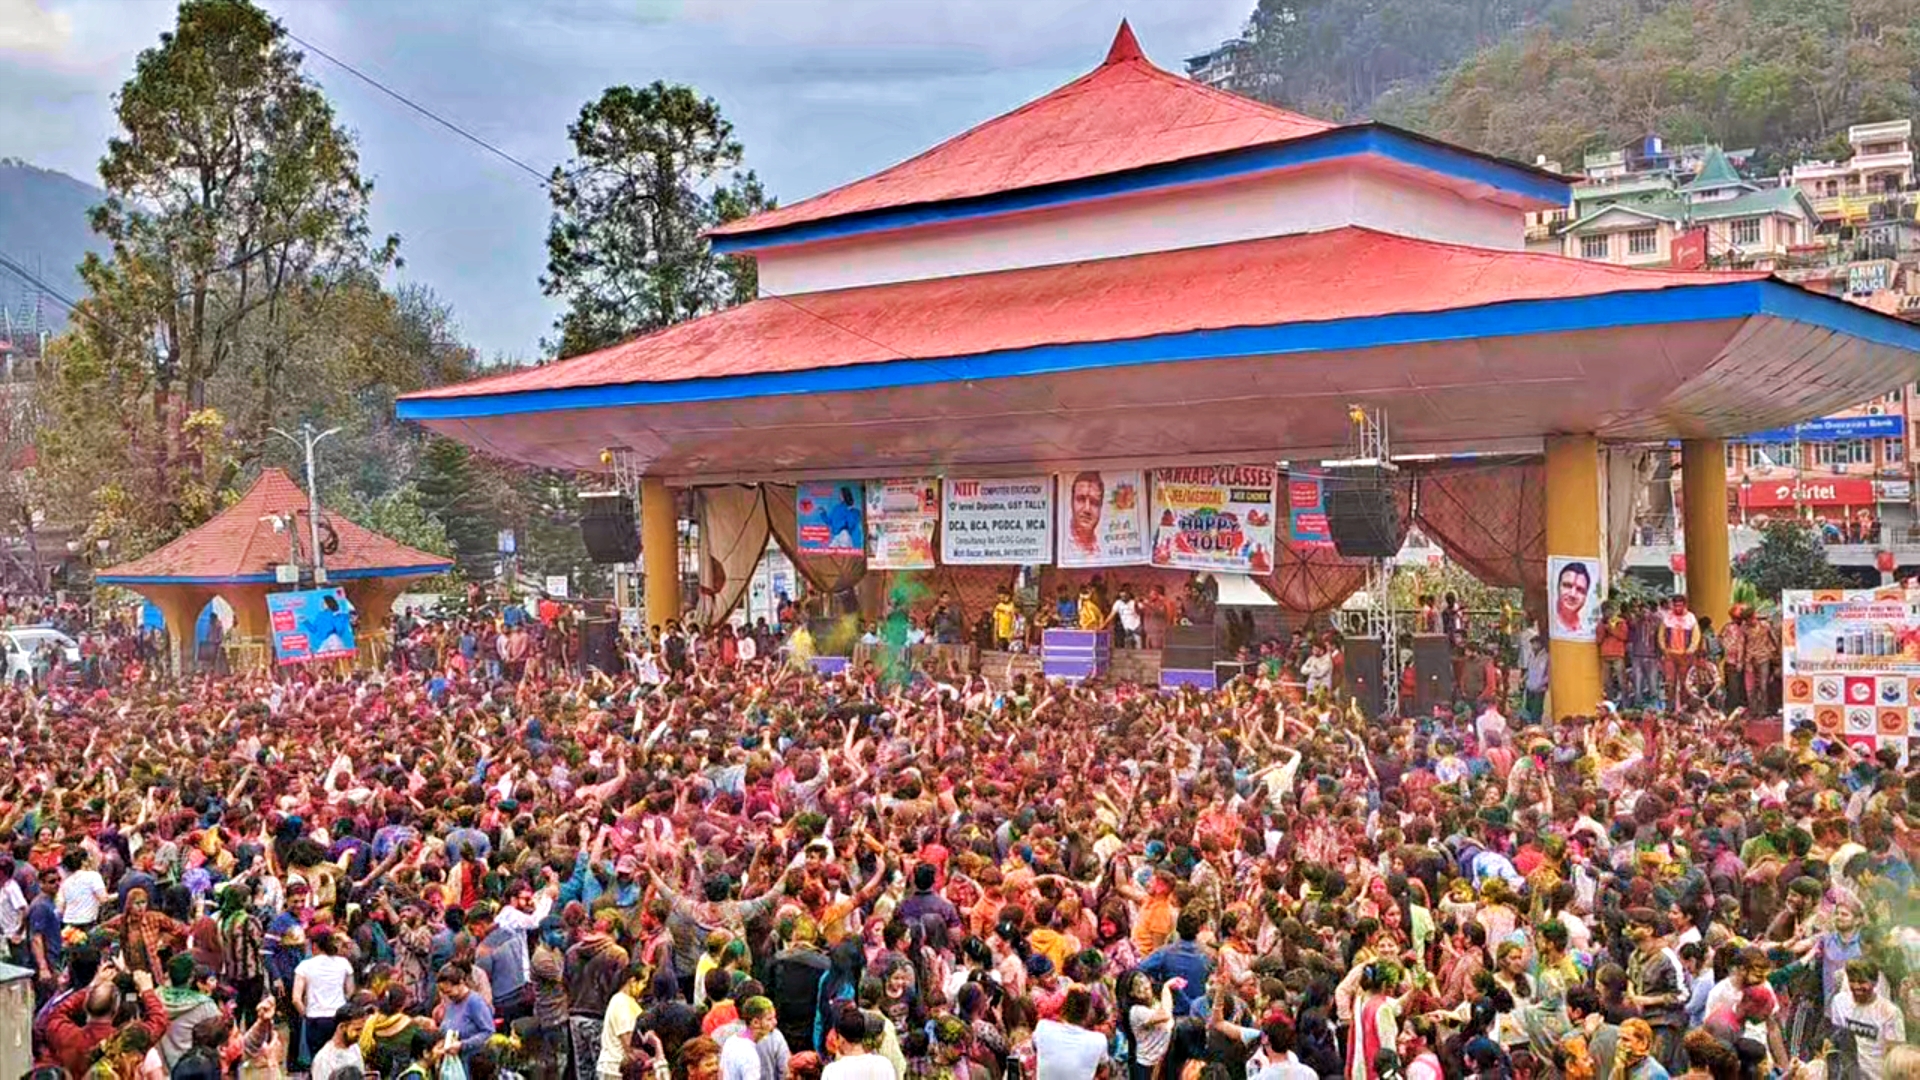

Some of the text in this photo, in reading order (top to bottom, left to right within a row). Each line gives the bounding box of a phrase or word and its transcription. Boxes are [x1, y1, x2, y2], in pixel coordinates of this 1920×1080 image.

[1849, 264, 1884, 278] ARMY
[1850, 278, 1885, 290] POLICE
[1219, 466, 1272, 486] CLASSES
[953, 481, 979, 496] NIIT
[1791, 483, 1836, 500] airtel
[1024, 500, 1046, 509] TALLY
[1026, 519, 1045, 530] MCA
[1178, 515, 1240, 532] HAPPY
[1186, 532, 1233, 550] HOLI
